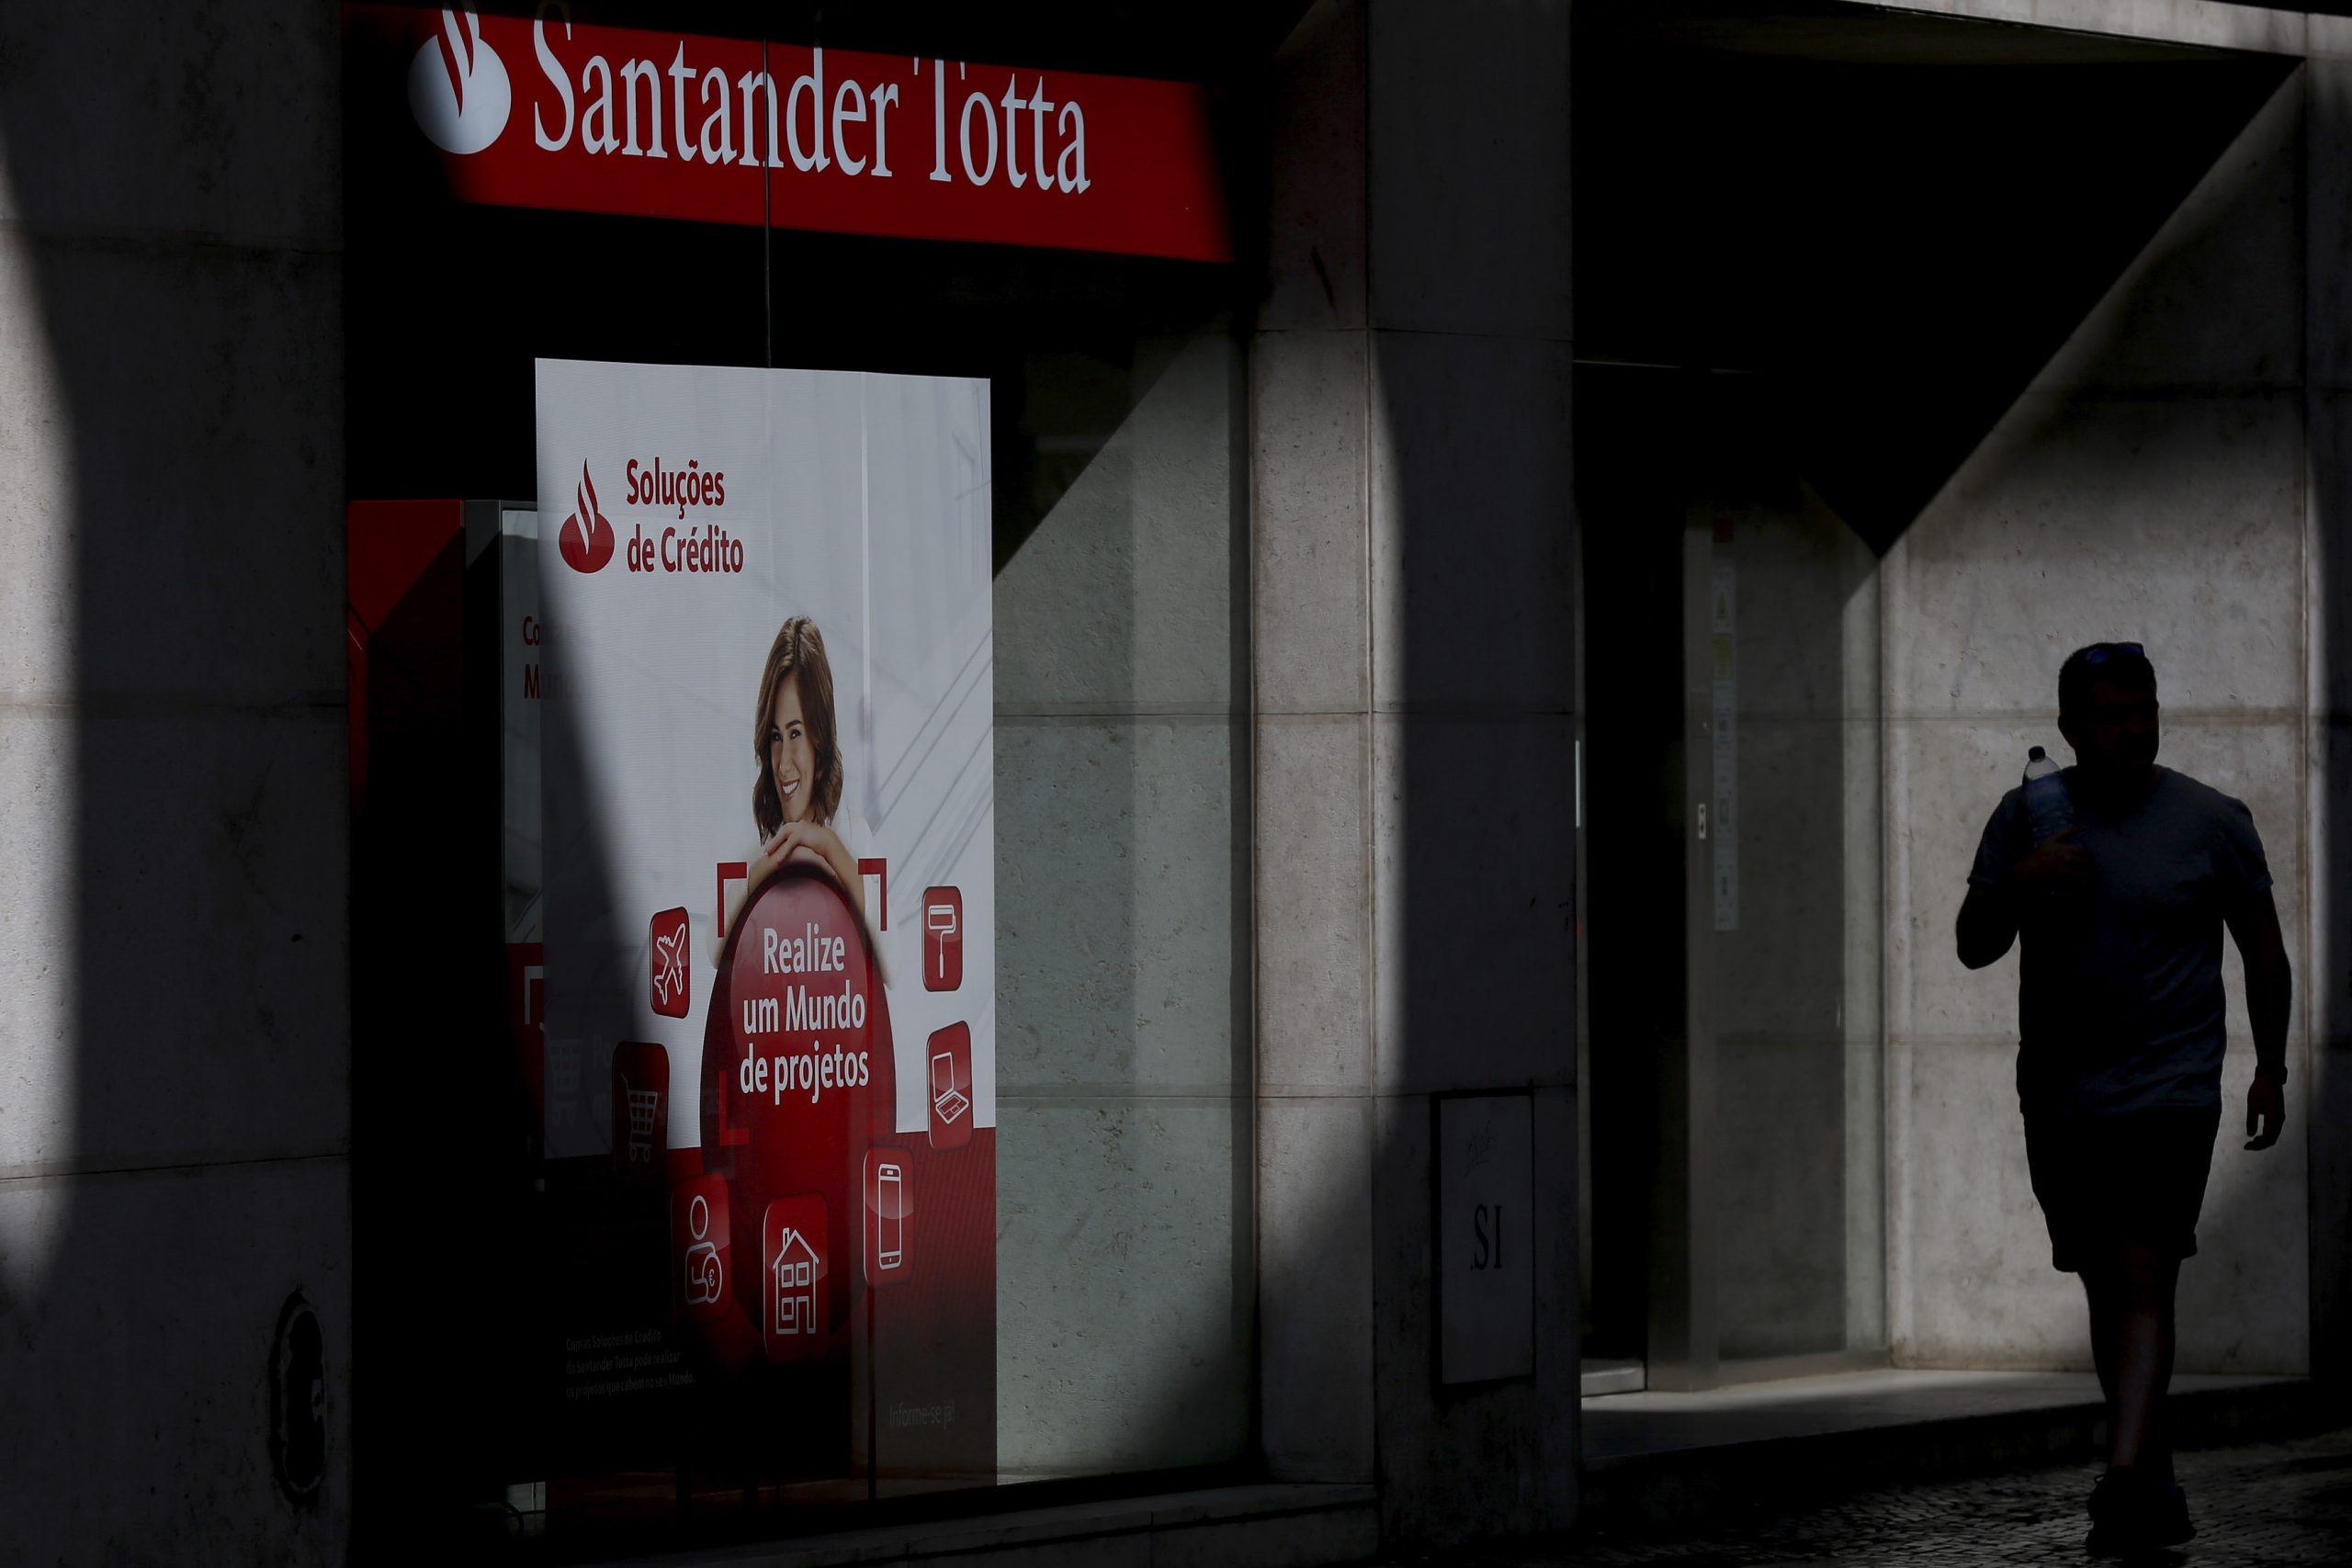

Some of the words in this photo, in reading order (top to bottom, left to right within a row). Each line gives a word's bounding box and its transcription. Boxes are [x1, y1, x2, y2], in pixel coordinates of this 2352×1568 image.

[533, 0, 899, 177] Santander
[912, 55, 1091, 195] Totta
[627, 457, 725, 520] Soluções
[627, 524, 655, 572] de
[661, 525, 744, 573] Crédito
[763, 922, 845, 974] Realize
[743, 997, 779, 1034] um
[786, 979, 865, 1032] Mundo
[740, 1043, 768, 1094] de
[774, 1040, 870, 1106] projetos
